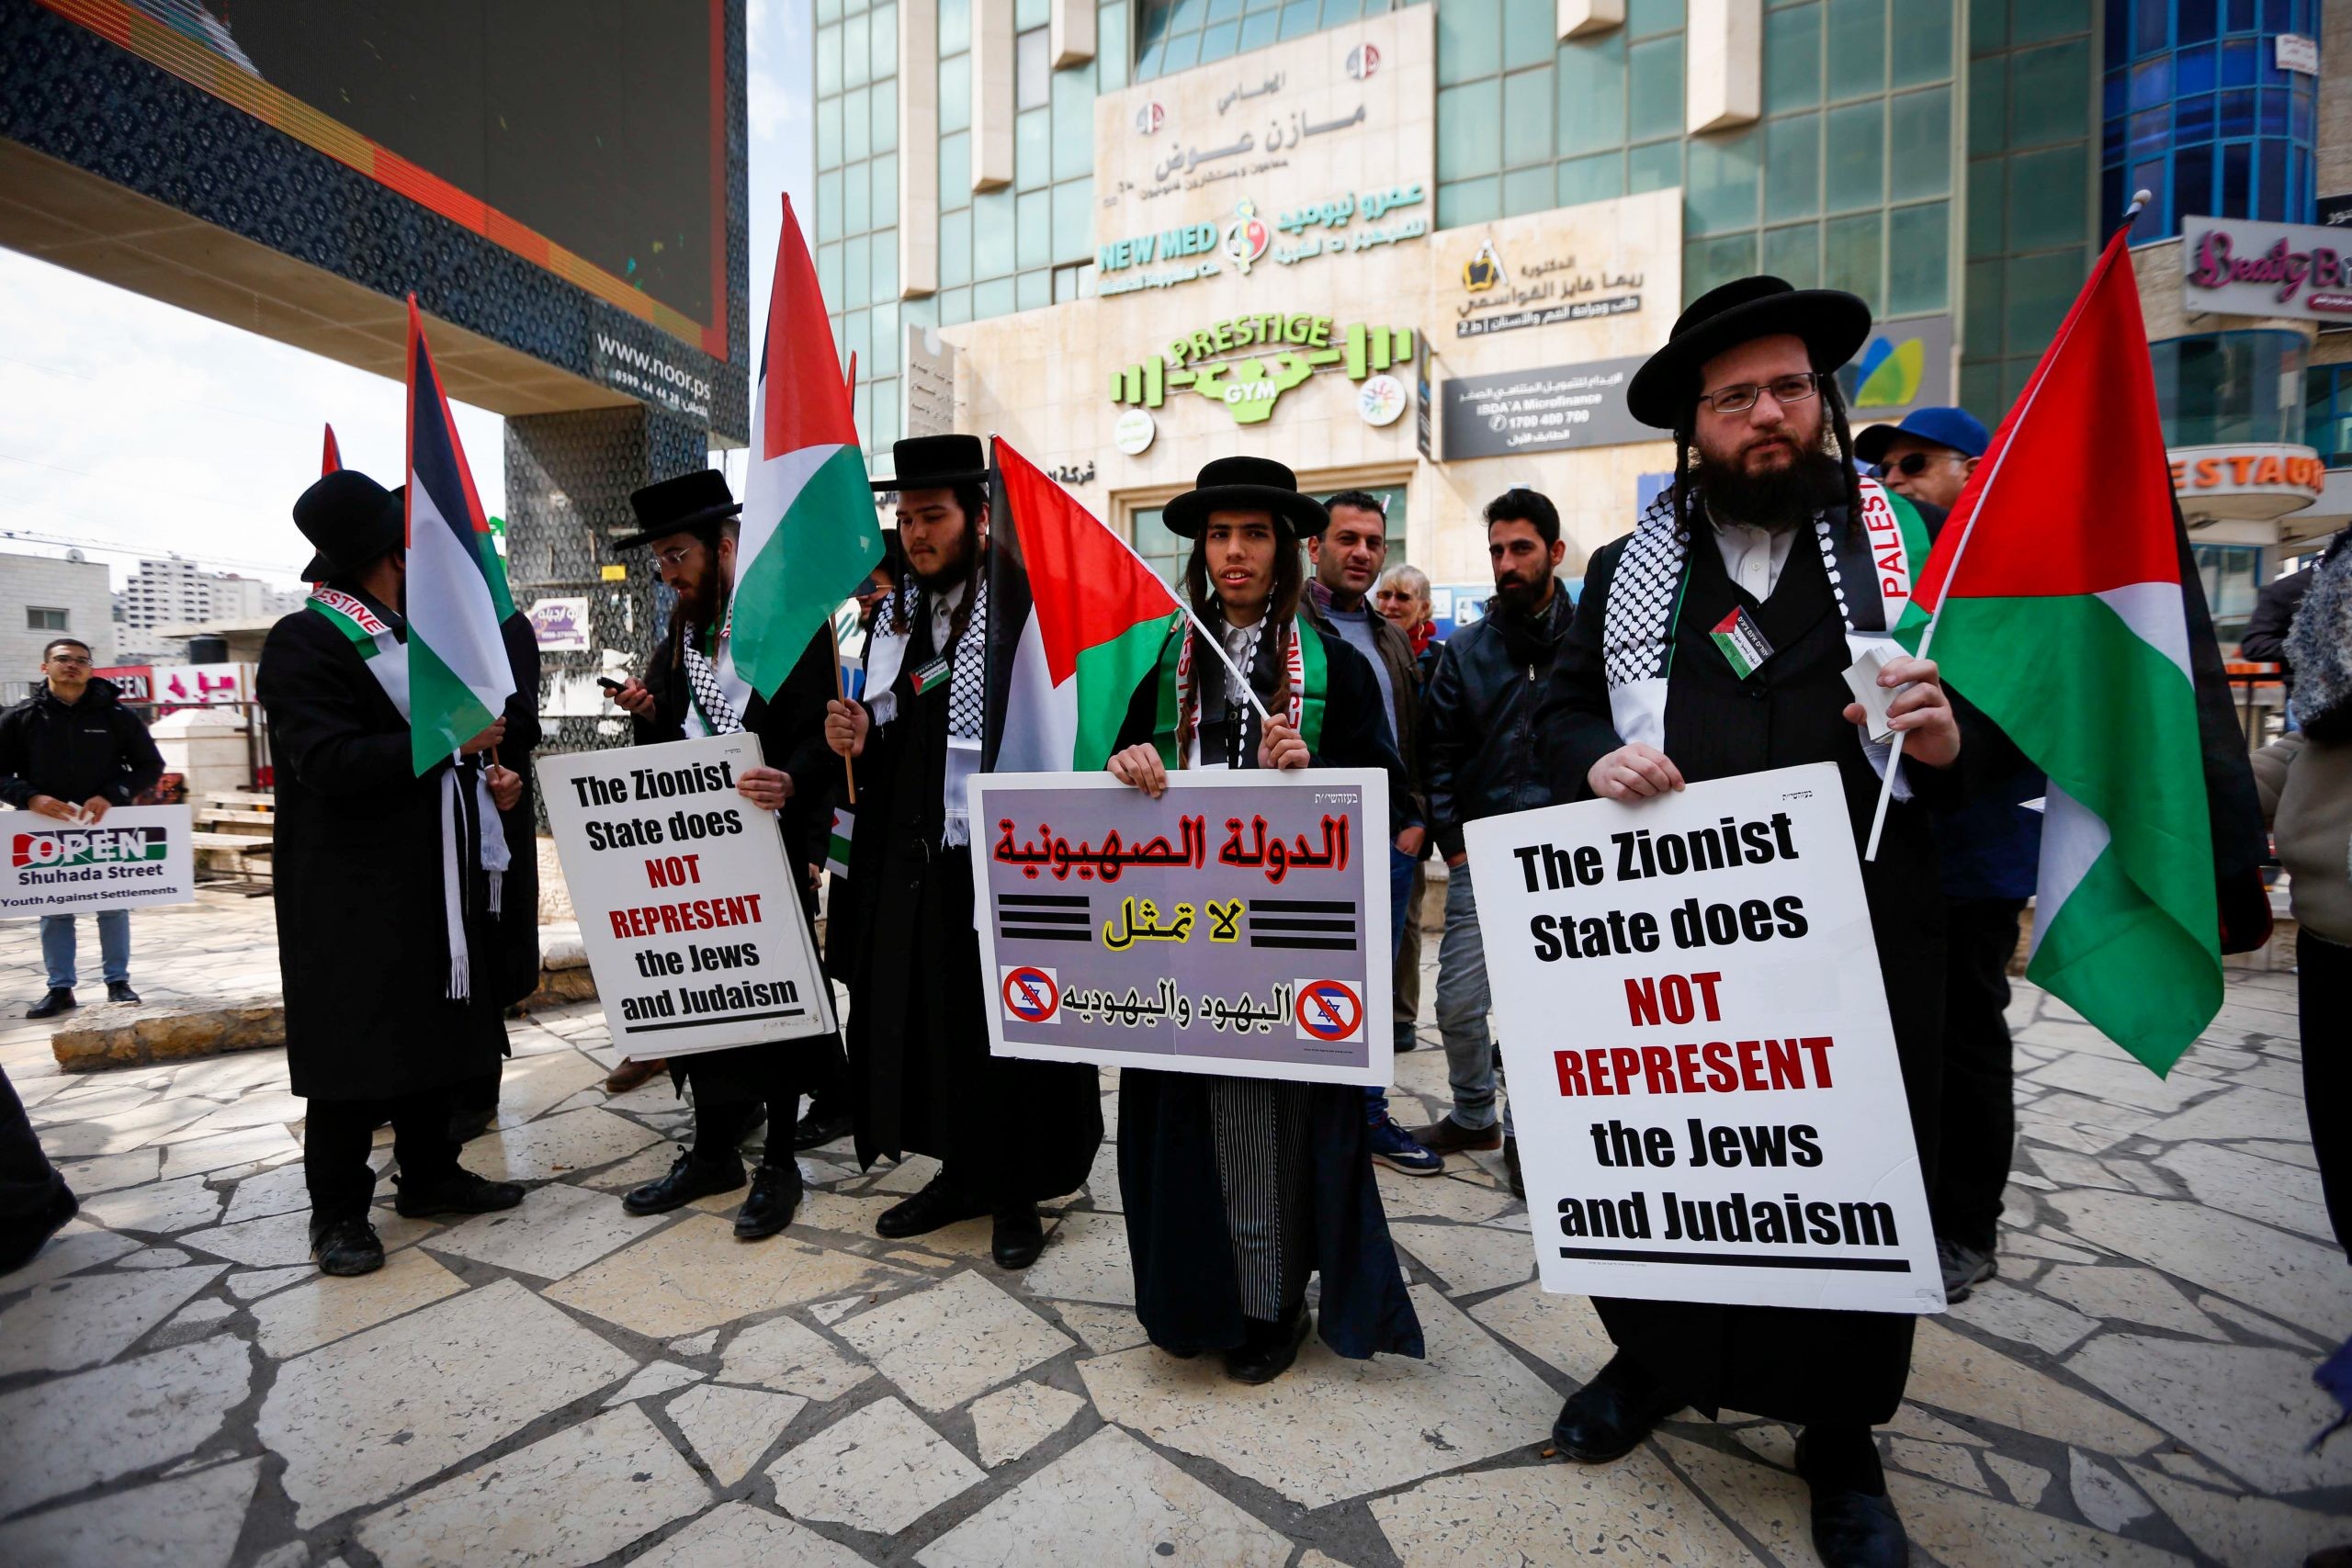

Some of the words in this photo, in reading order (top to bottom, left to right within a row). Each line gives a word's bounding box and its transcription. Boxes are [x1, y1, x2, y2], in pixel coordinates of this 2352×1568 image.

[1099, 235, 1155, 273] NEW
[1160, 221, 1218, 260] MED
[1168, 312, 1335, 368] PRESTIGE
[597, 333, 710, 400] www.noor.ps
[1224, 379, 1277, 404] GYM
[1522, 393, 1602, 412] Microfinance
[1510, 414, 1538, 430] 1700
[1566, 410, 1589, 424] 700
[571, 776, 628, 807] The
[630, 761, 735, 800] Zionist
[28, 831, 147, 863] OPEN
[585, 818, 663, 851] State
[668, 809, 742, 842] does
[994, 815, 1206, 883] الصهيونية
[1218, 815, 1349, 884] الدولة
[1513, 844, 1603, 893] The
[1611, 812, 1799, 882] Zionist
[18, 866, 102, 886] Shuhada
[108, 863, 164, 879] Street
[646, 854, 700, 887] NOT
[1, 896, 43, 907] Youth
[46, 892, 98, 904] Against
[100, 886, 178, 900] Settlements
[609, 895, 762, 939] REPRESENT
[1205, 897, 1246, 942] لا
[1102, 896, 1195, 951] تمثل
[1531, 910, 1659, 962] State
[1671, 896, 1808, 950] does
[635, 949, 684, 977] the
[689, 942, 761, 972] Jews
[621, 990, 676, 1021] and
[679, 979, 798, 1015] Judaism
[1199, 983, 1293, 1032] اليهود
[1625, 971, 1721, 1026] NOT
[1554, 1036, 1833, 1096] REPRESENT
[1590, 1120, 1675, 1168] the
[1688, 1118, 1824, 1168] Jews
[1558, 1191, 1651, 1239] and
[1662, 1191, 1899, 1247] Judaism
